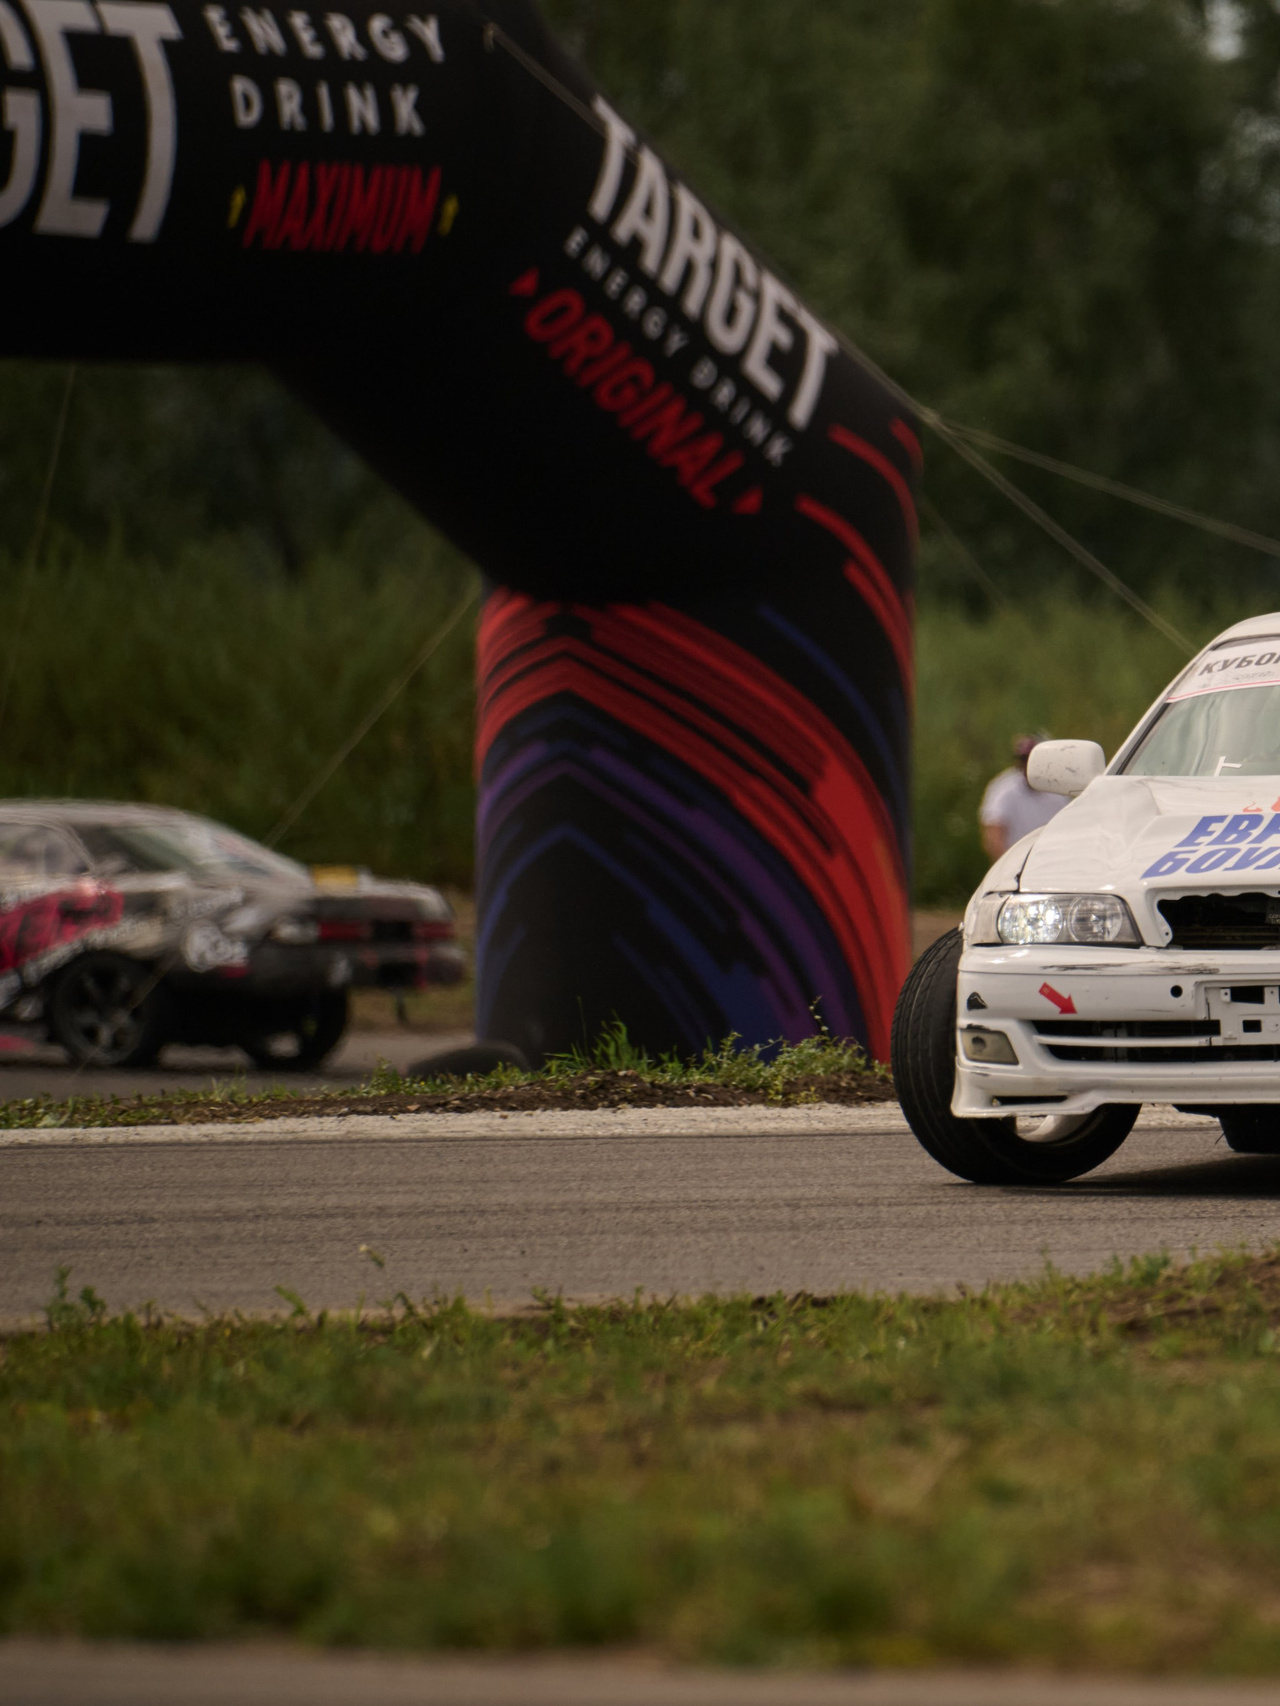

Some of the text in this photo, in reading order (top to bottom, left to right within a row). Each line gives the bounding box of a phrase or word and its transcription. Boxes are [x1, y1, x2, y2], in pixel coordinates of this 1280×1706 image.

[205, 4, 445, 63] ENERGY
[229, 74, 425, 136] DRINK
[243, 158, 442, 254] MAXIMUM
[587, 93, 839, 431] TARGET
[524, 288, 745, 508] ORIGINAL
[564, 225, 793, 466] ENERGY DRINK
